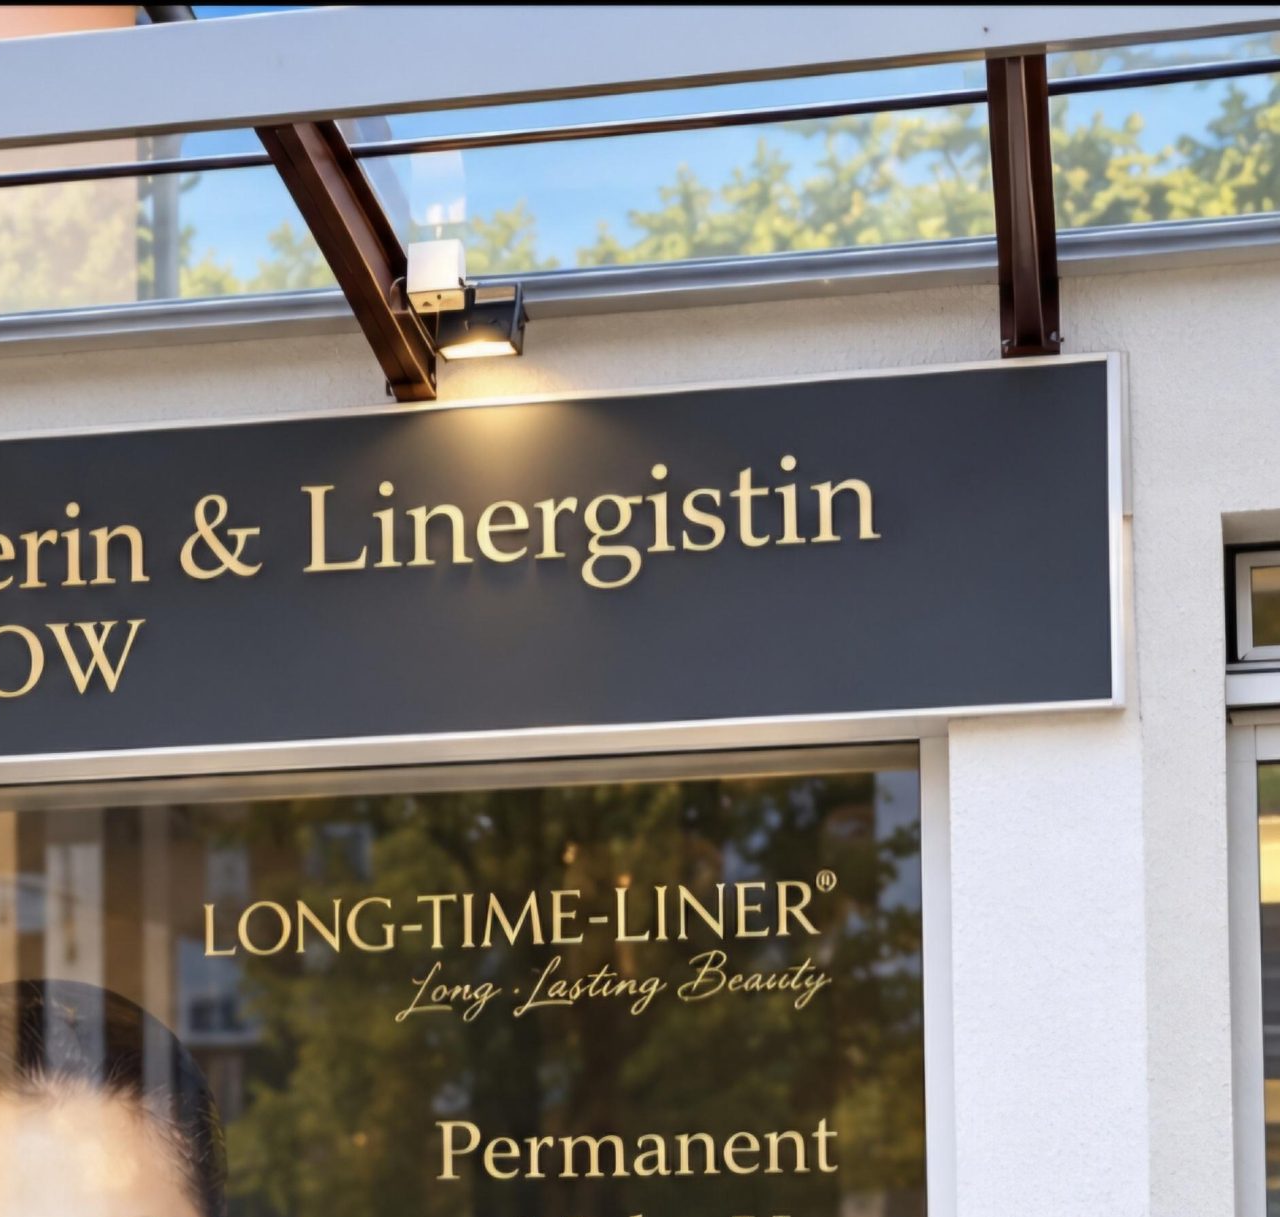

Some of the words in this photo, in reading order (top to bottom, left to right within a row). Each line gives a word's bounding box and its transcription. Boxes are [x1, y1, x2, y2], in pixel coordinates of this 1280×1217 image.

[179, 493, 263, 579] &
[301, 455, 881, 589] Linergistin
[678, 949, 833, 1011] Beauty
[435, 1118, 839, 1180] Permanent
